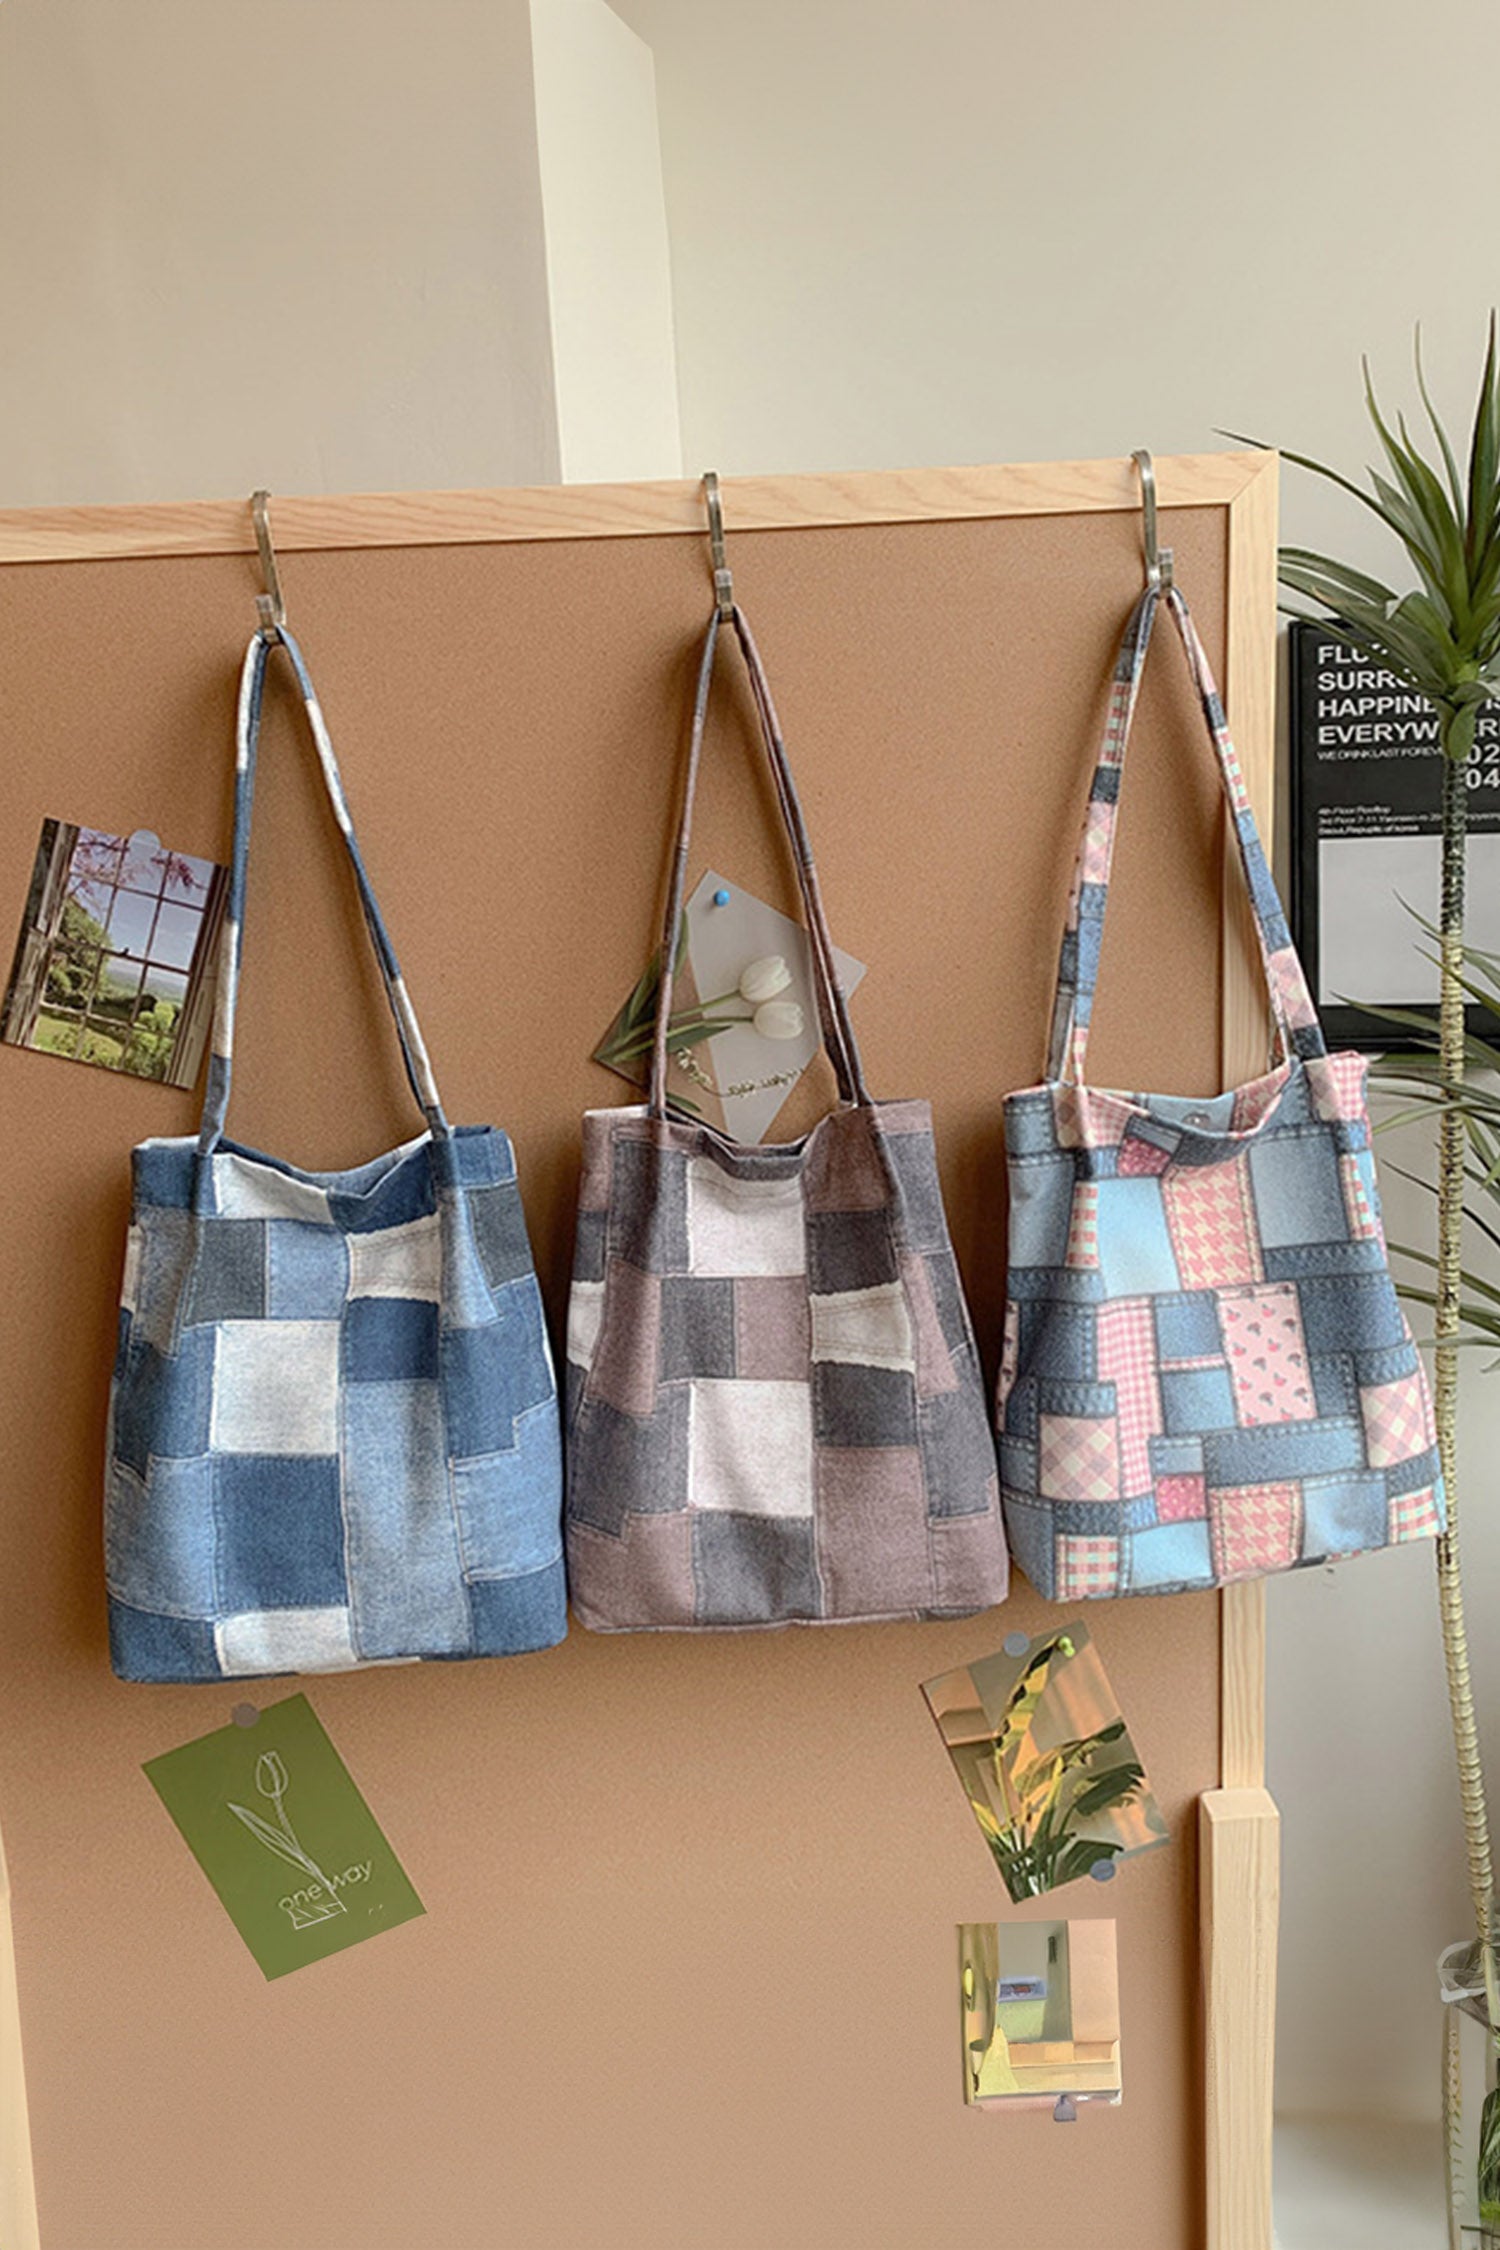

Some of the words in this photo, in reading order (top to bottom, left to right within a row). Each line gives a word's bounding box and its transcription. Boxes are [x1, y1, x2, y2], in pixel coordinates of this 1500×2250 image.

[1400, 746, 1443, 758] FOREV
[277, 1883, 322, 1911] one
[328, 1860, 372, 1891] way
